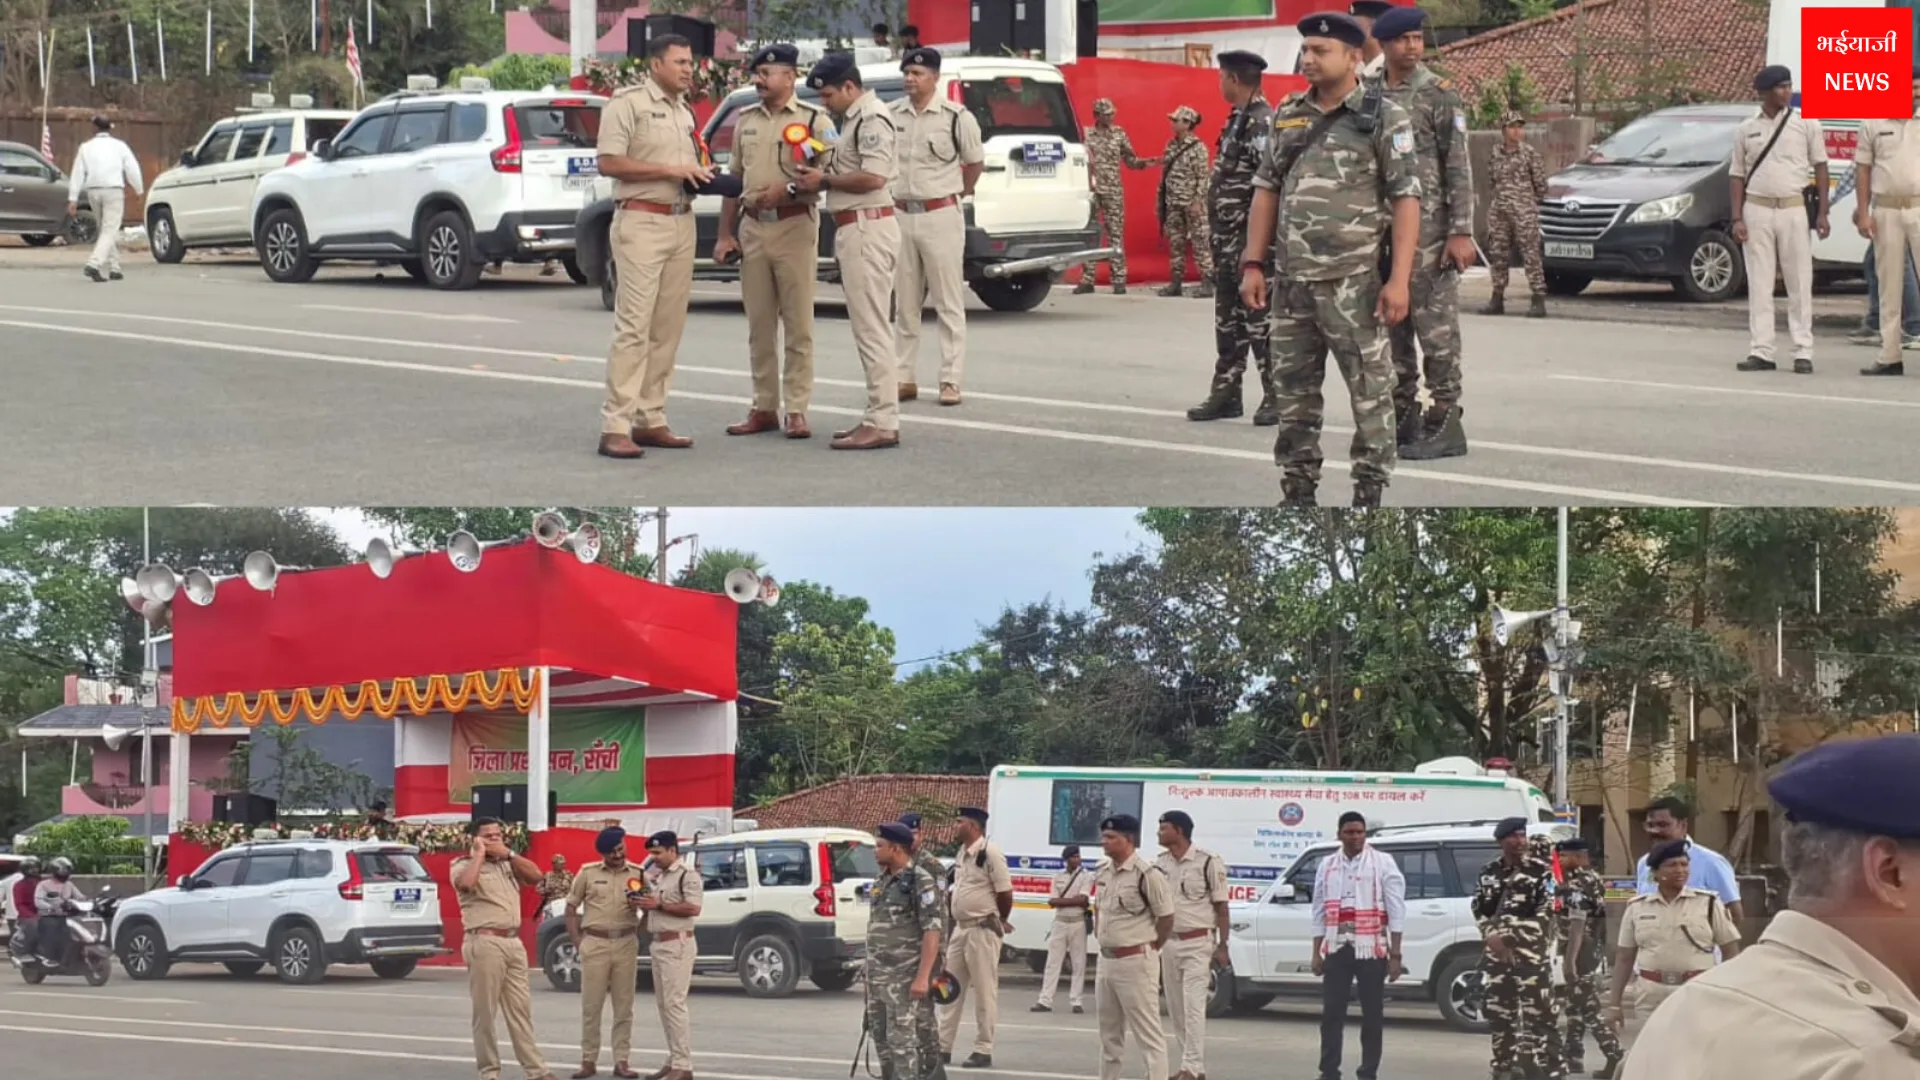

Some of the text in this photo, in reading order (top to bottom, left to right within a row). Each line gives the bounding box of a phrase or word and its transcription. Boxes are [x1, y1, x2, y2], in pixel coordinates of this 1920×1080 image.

[469, 744, 507, 772] जिला
[1343, 791, 1360, 800] 108
[1362, 791, 1375, 800] पर
